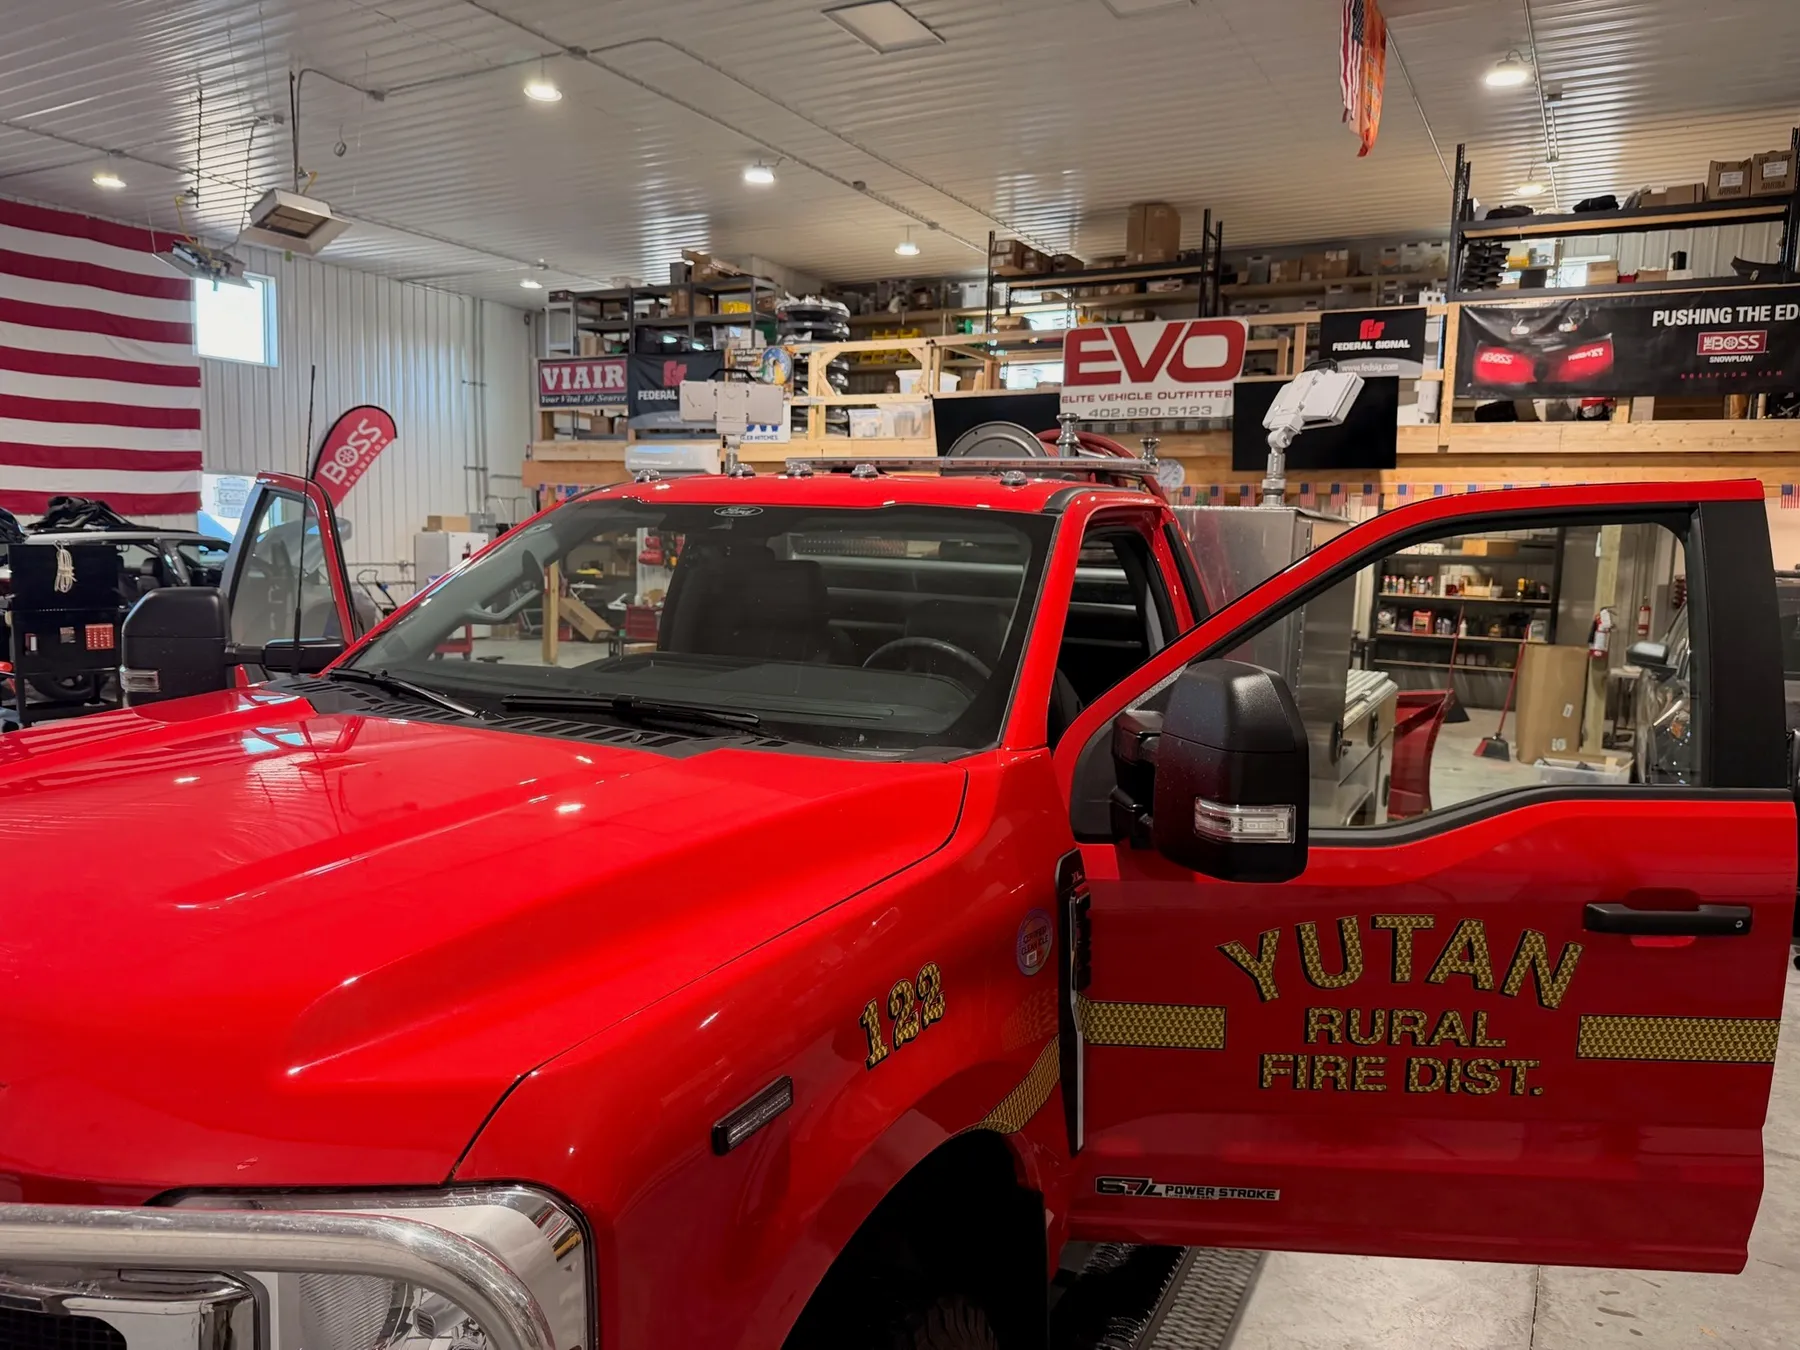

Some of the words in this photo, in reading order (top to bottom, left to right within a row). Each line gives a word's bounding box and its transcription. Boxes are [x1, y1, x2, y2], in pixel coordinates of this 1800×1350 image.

[1652, 307, 1733, 327] PUSHING
[1736, 305, 1772, 323] THE
[1775, 303, 1800, 321] ED
[1064, 319, 1247, 387] EVO
[1332, 341, 1373, 352] FEDERAL
[1374, 339, 1411, 350] SIGNAL
[1711, 335, 1760, 351] BOSS
[1341, 364, 1399, 373] www.fedsig.com
[1709, 355, 1754, 364] SNOWPLOW
[542, 364, 625, 391] VIAIR
[637, 390, 678, 400] FEDERAL
[1061, 396, 1095, 404] ELITE
[1099, 392, 1152, 402] VEHICLE
[1157, 389, 1232, 400] OUTFITTER
[1088, 405, 1212, 418] 402.990.5123
[320, 418, 382, 485] BOSS
[1215, 914, 1585, 1010] YUTAN
[859, 960, 947, 1071] 122
[1304, 1006, 1507, 1048] RURAL
[1259, 1053, 1389, 1091] FIRE
[1404, 1055, 1545, 1096] DIST.
[1165, 1185, 1217, 1197] POWER
[1218, 1187, 1276, 1200] STROKE
